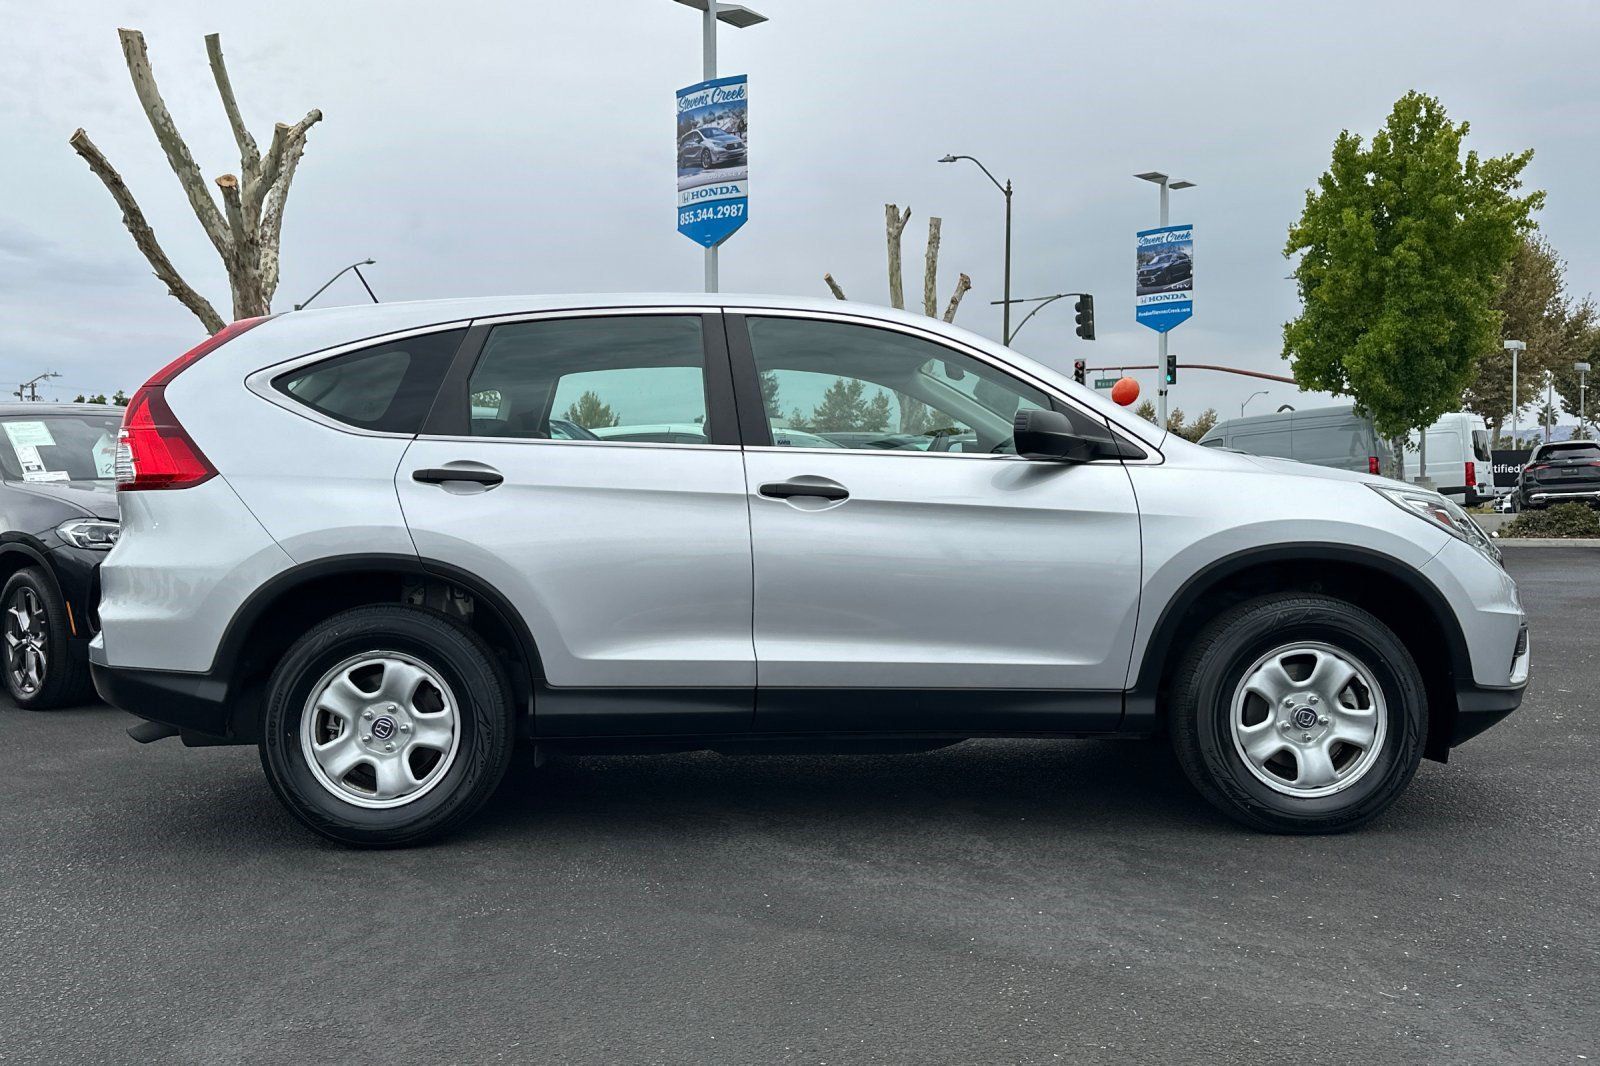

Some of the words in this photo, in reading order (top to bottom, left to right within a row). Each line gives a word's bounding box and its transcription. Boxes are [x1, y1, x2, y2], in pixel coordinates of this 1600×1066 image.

[678, 93, 710, 112] Stevens
[711, 86, 745, 104] Creek
[691, 185, 741, 199] HONDA
[680, 204, 744, 226] 855.344.2987
[1166, 231, 1191, 243] Creek
[1148, 293, 1187, 302] HONDA
[1493, 464, 1520, 473] tified
